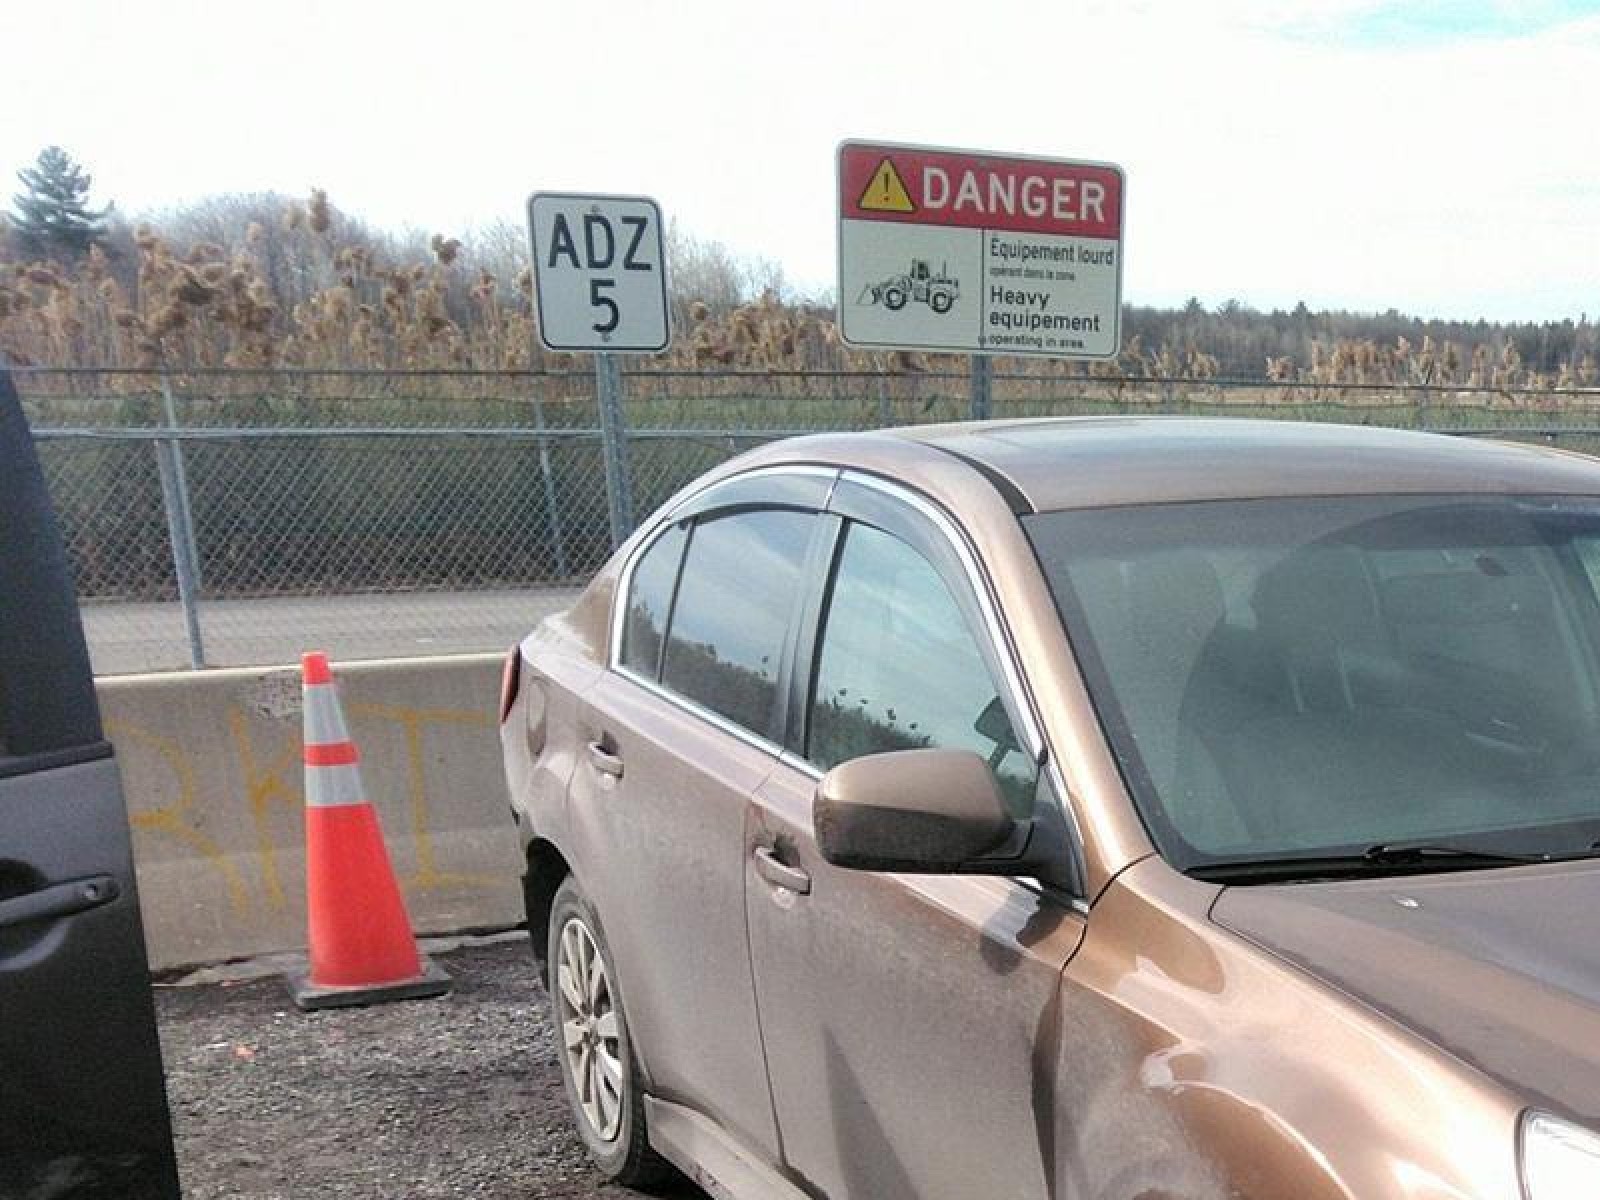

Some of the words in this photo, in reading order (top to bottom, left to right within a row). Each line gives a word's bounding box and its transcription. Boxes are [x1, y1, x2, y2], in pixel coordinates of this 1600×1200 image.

[923, 167, 1105, 222] DANGER
[548, 213, 653, 271] ADZ
[590, 278, 619, 333] 5
[989, 308, 1100, 332] equipement
[990, 285, 1051, 311] Heavy
